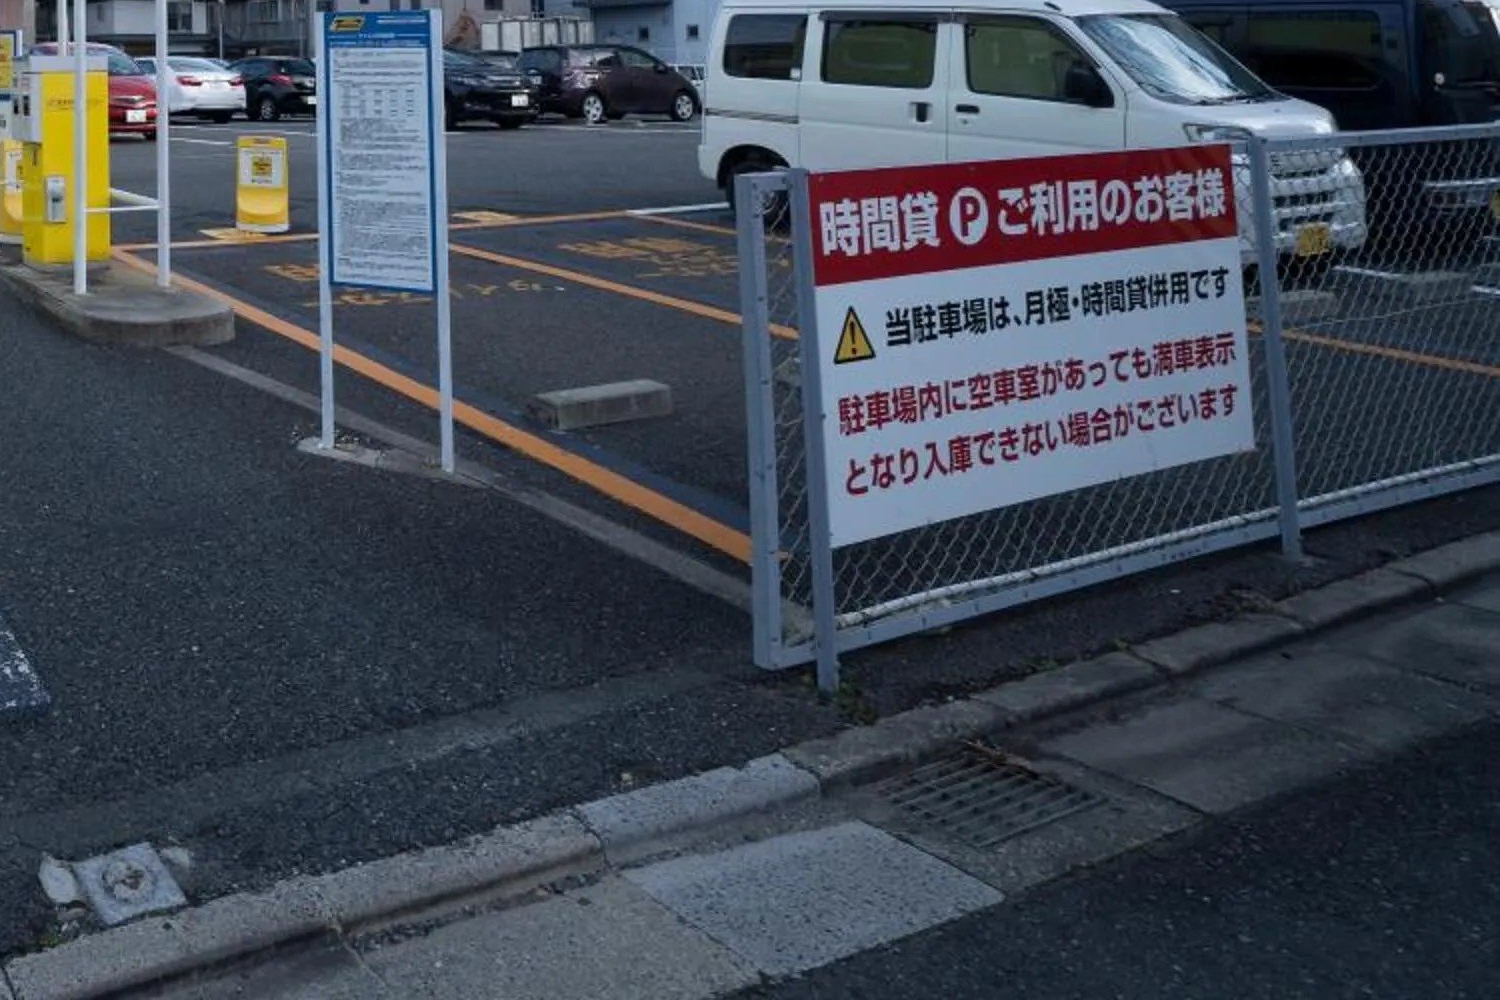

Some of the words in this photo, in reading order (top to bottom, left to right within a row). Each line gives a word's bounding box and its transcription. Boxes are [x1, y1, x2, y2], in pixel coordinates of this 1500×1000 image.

[819, 190, 941, 257] 時間貸
[997, 167, 1228, 237] ご利用のお客様
[885, 266, 1230, 348] 当駐車場は、月極・時間貸併用です
[838, 331, 1236, 437] 駐車場内に空車室があっても満車表示
[844, 383, 1239, 497] となり入庫できない場合がございます
